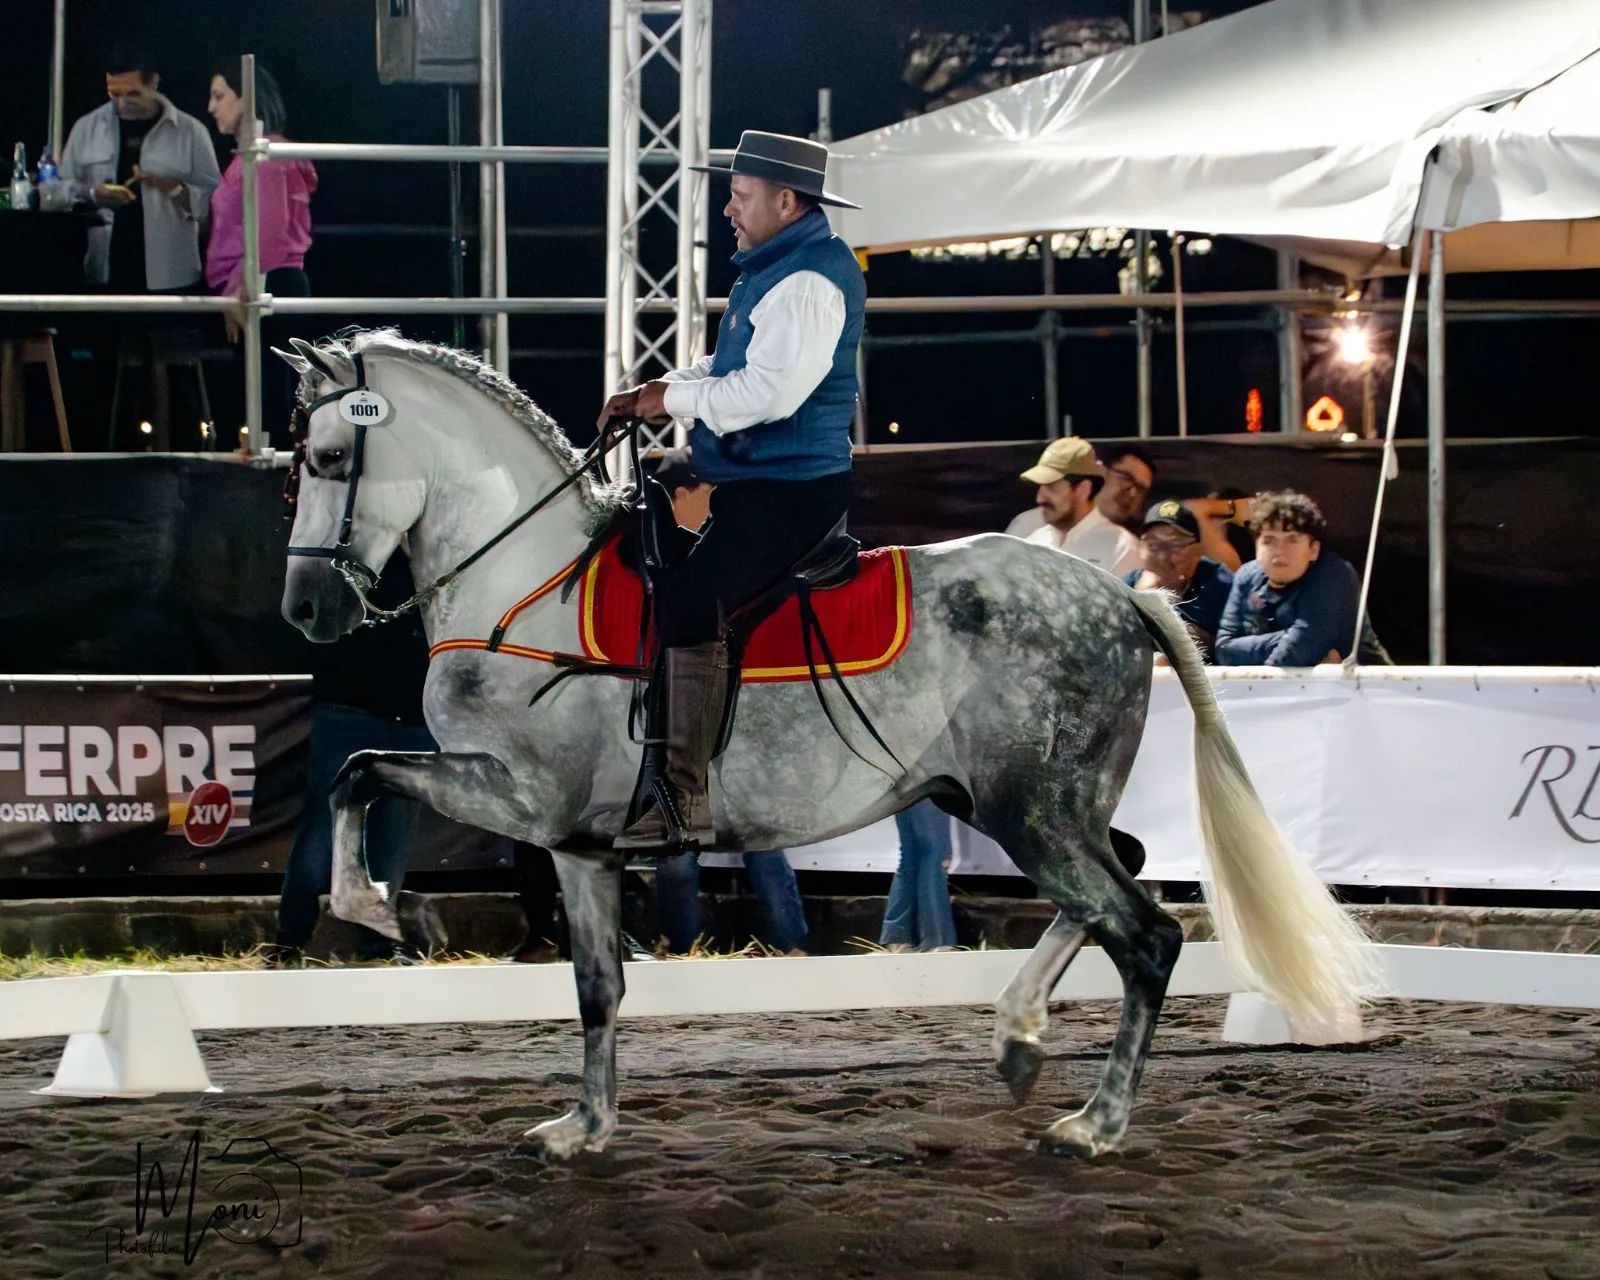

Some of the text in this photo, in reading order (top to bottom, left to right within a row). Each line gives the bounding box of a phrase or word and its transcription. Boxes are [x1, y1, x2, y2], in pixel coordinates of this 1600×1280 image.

[350, 404, 379, 417] 1001
[54, 803, 101, 823] RICA
[106, 803, 156, 822] 2025
[189, 803, 229, 826] XIV
